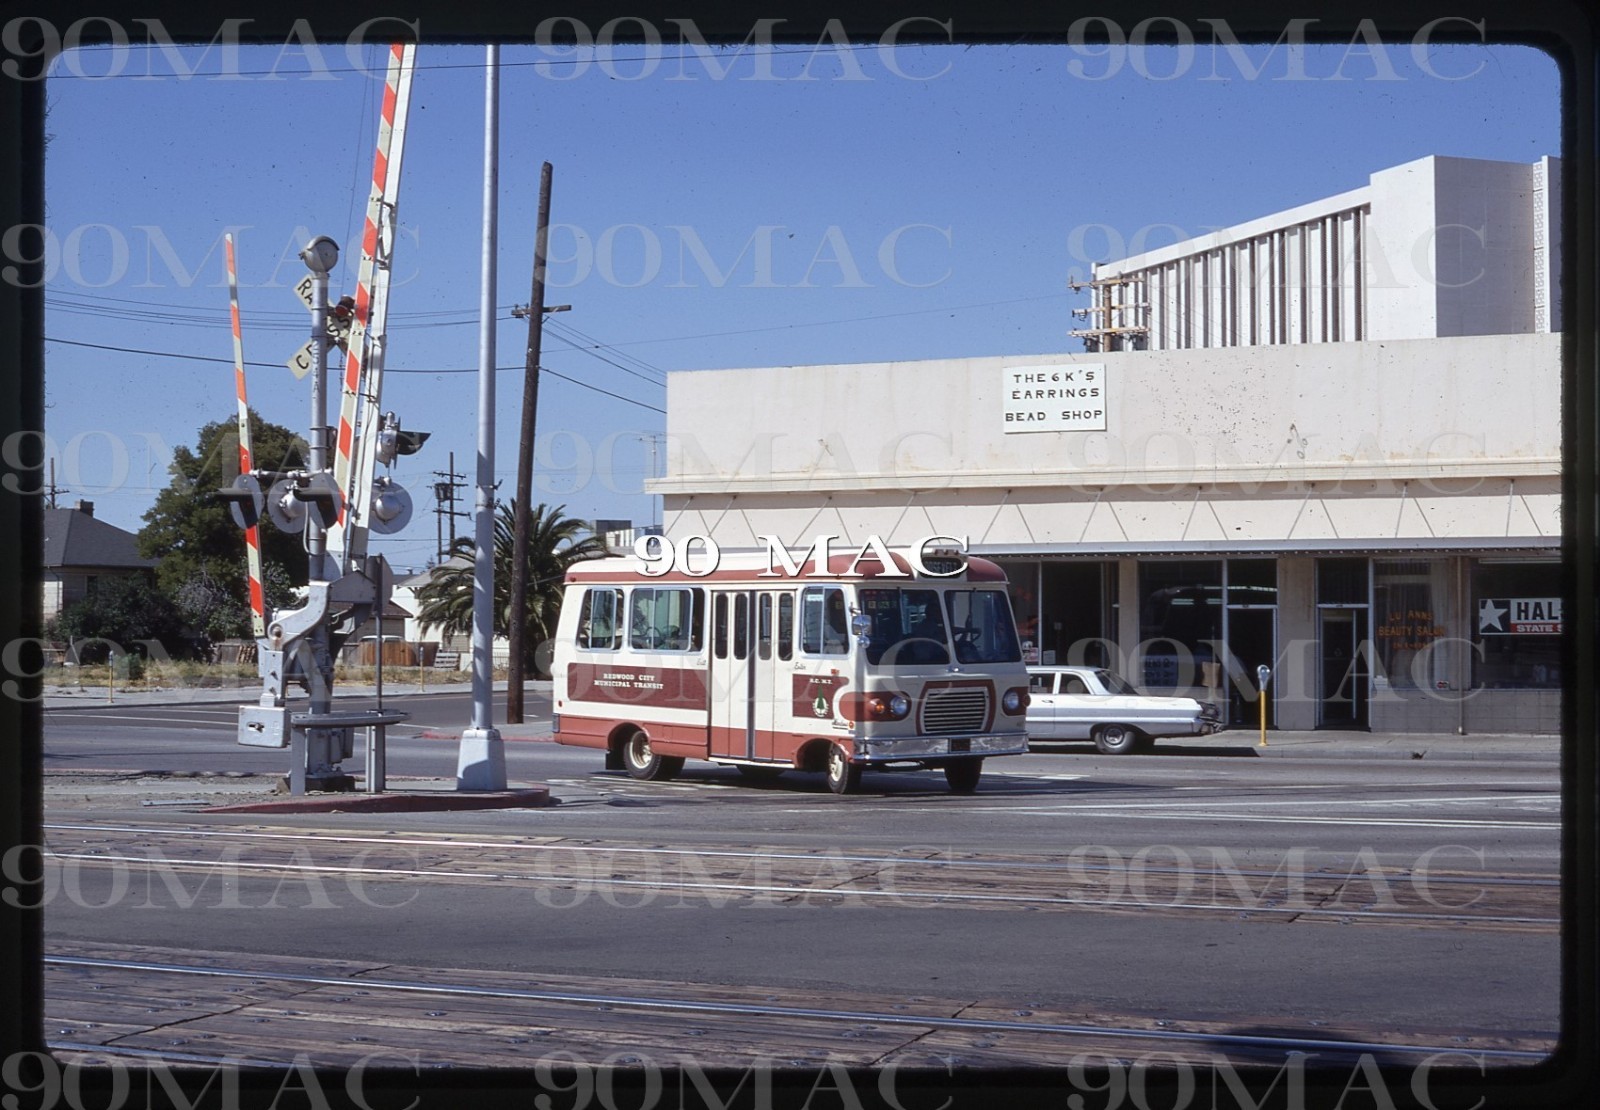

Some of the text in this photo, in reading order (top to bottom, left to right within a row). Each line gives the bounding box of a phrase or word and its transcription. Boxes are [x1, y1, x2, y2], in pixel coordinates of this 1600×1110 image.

[1013, 369, 1095, 383] THE 6 K'S
[1012, 388, 1100, 400] EARRINGS
[1005, 410, 1103, 422] BEAD SHOP
[1517, 601, 1562, 621] HAL
[1378, 626, 1413, 636] BEAUTY
[1516, 624, 1553, 632] STATE
[603, 673, 655, 682] REDWOOD CITY
[594, 680, 664, 690] MUNICIPAL TRANSIT
